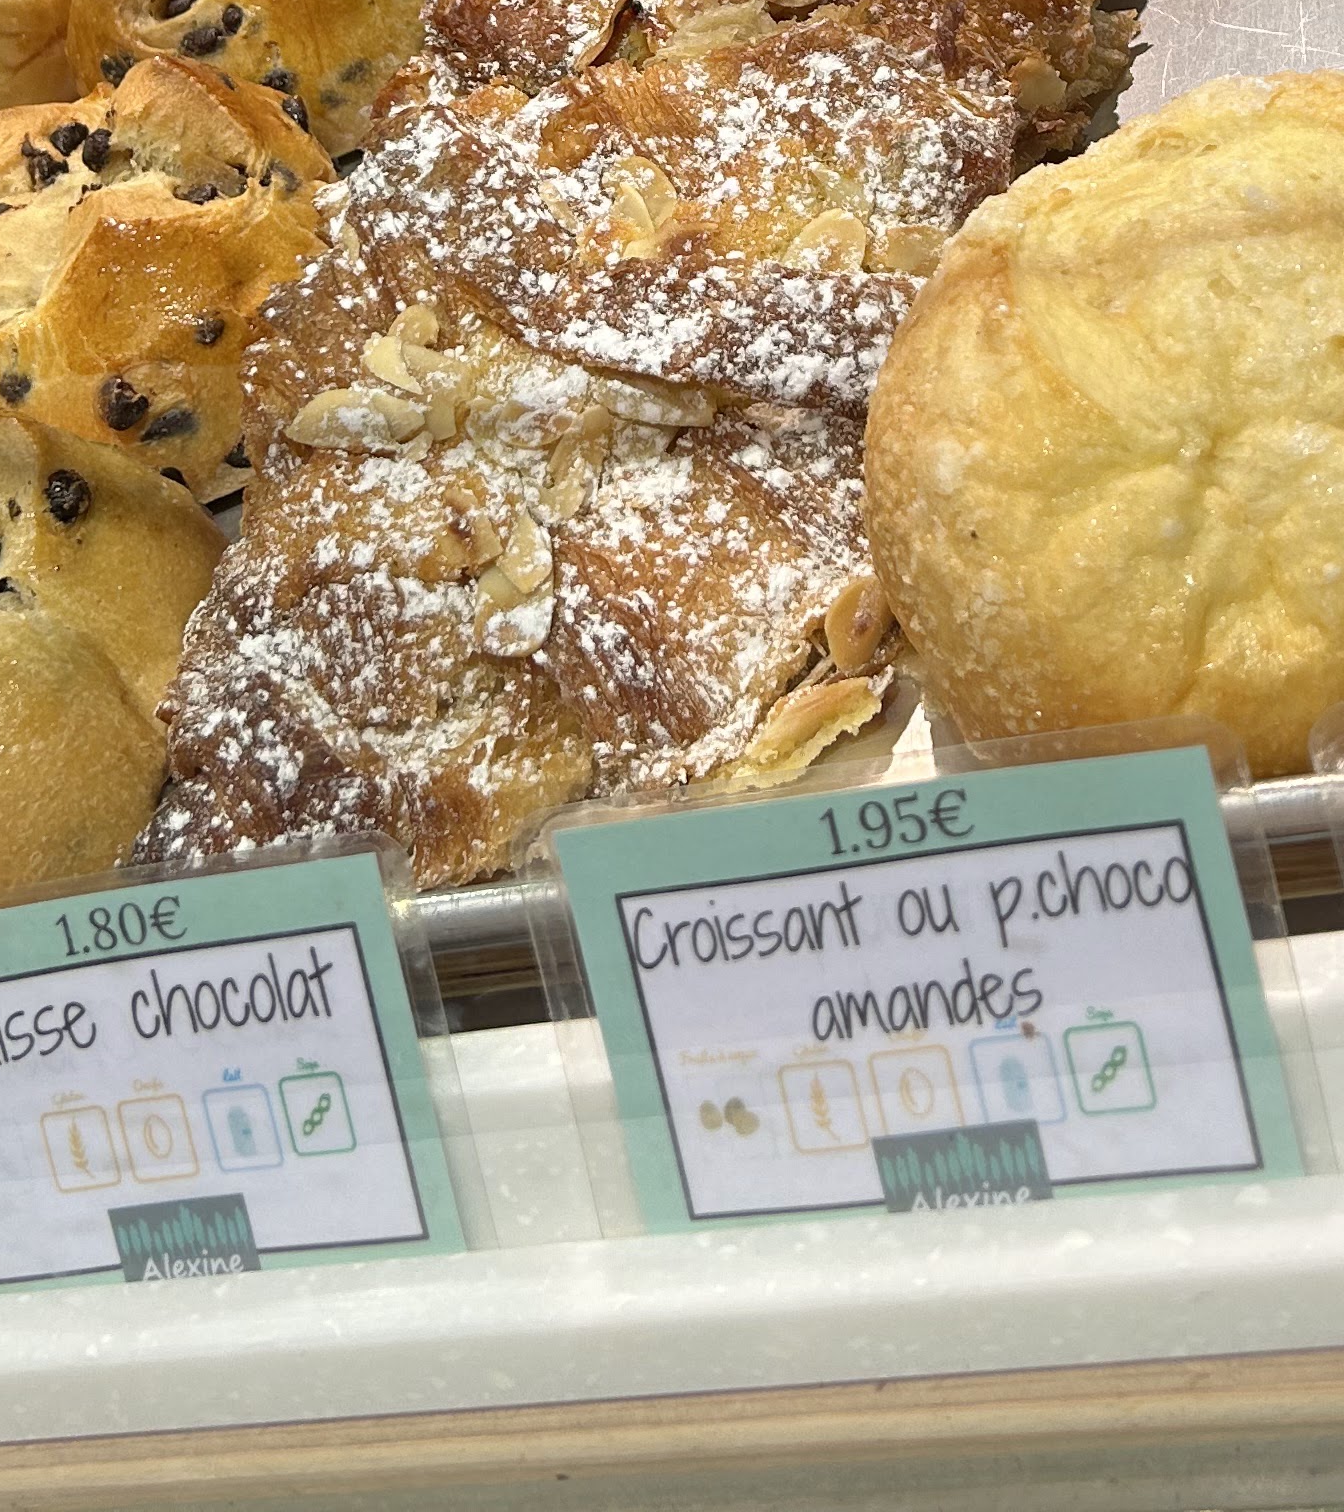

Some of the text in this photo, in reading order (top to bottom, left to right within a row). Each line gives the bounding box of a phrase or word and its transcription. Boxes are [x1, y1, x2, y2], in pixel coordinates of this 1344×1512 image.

[818, 787, 976, 856] 1.95€
[55, 895, 188, 957] 1.80€
[631, 851, 1197, 971] Croissant ou p.choco
[131, 946, 334, 1039] chocolat
[811, 958, 1045, 1043] amandes
[141, 1248, 245, 1281] Alexine
